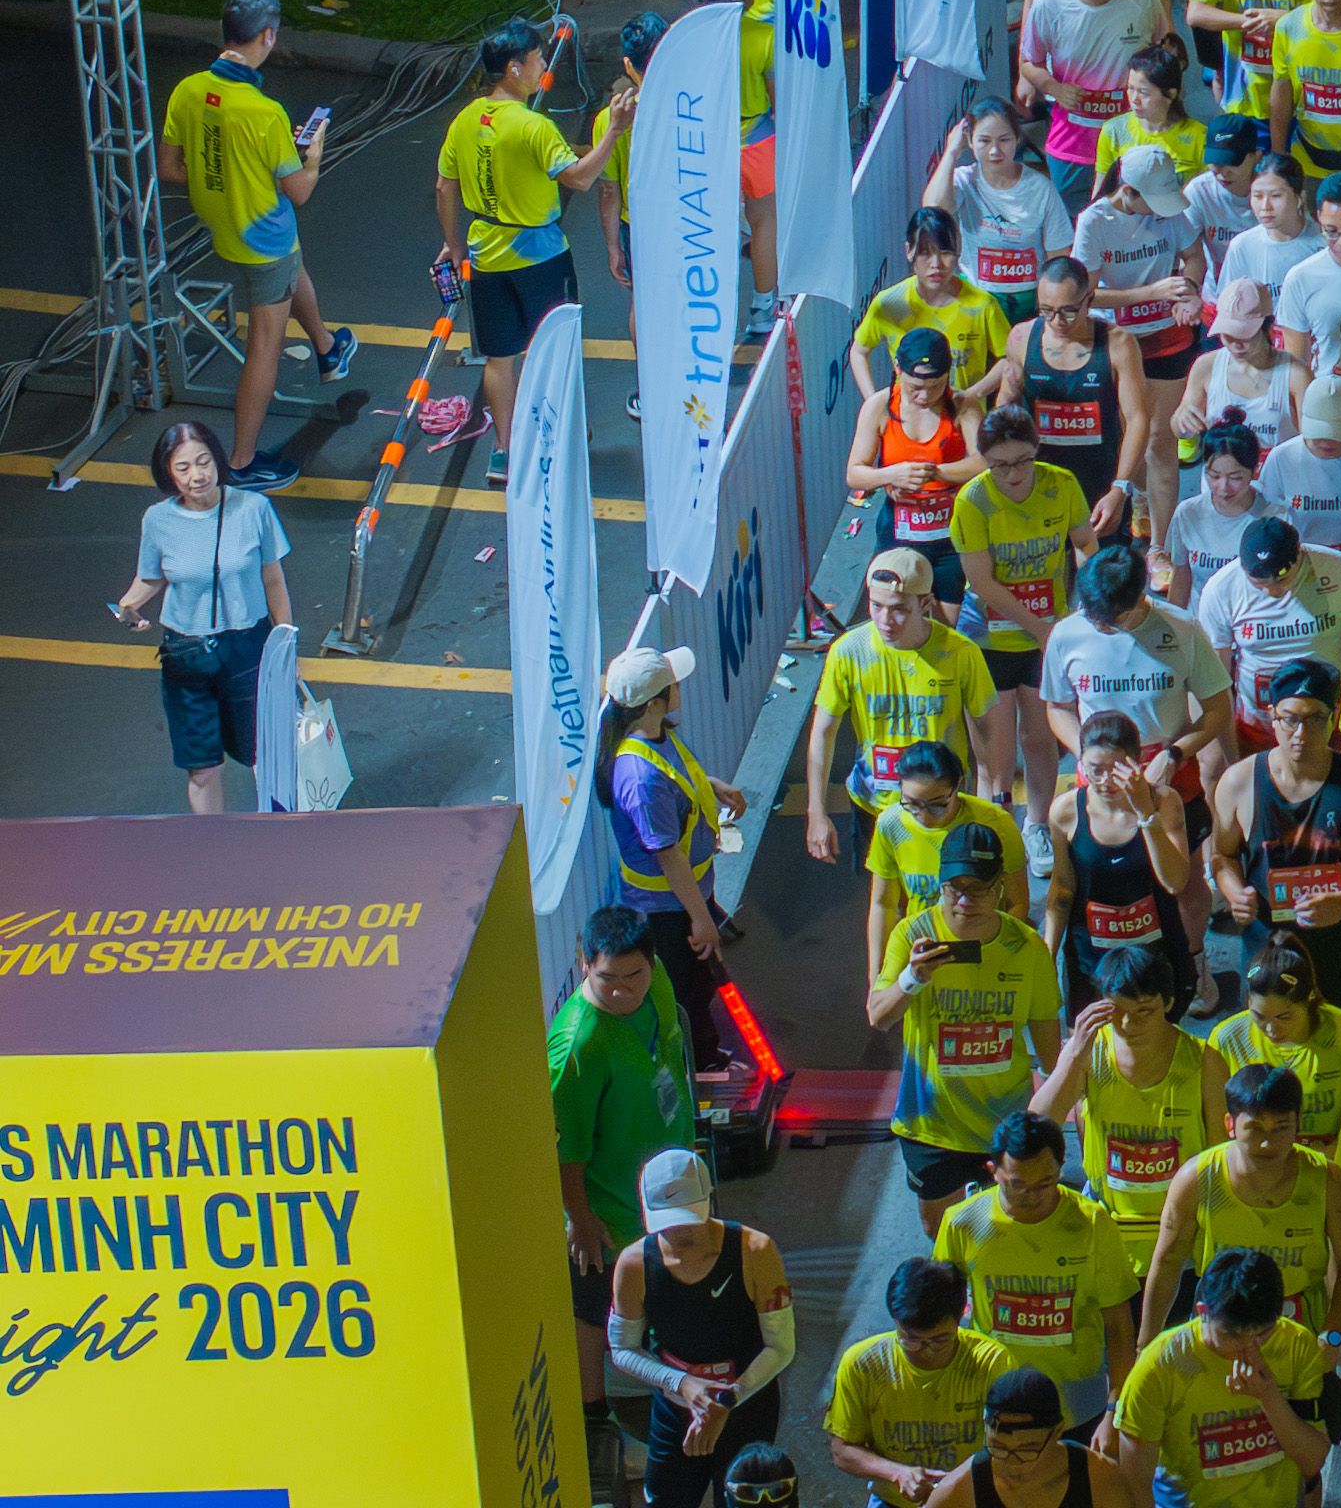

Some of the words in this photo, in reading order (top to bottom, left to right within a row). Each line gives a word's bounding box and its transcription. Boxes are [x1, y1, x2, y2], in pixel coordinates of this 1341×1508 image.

[992, 263, 1032, 276] 81408
[1053, 415, 1095, 429] 81438
[911, 508, 950, 524] 81947
[1241, 615, 1336, 641] #Dirunforlife
[1078, 673, 1174, 693] #Dirunforlife
[866, 693, 946, 713] MIDNIGHT
[887, 716, 928, 737] 2026
[49, 909, 147, 936] CITY
[152, 907, 271, 934] MINH
[275, 905, 352, 931] CHI
[359, 902, 422, 929] HO
[1109, 913, 1153, 933] 81520
[84, 934, 401, 974] VNEXPRESS
[961, 1041, 1005, 1058] 82157
[46, 1116, 358, 1180] MARATHON
[1125, 1156, 1174, 1174] 82607
[203, 1190, 359, 1268] CITY
[178, 1279, 376, 1362] 2026
[1017, 1311, 1066, 1327] 83110
